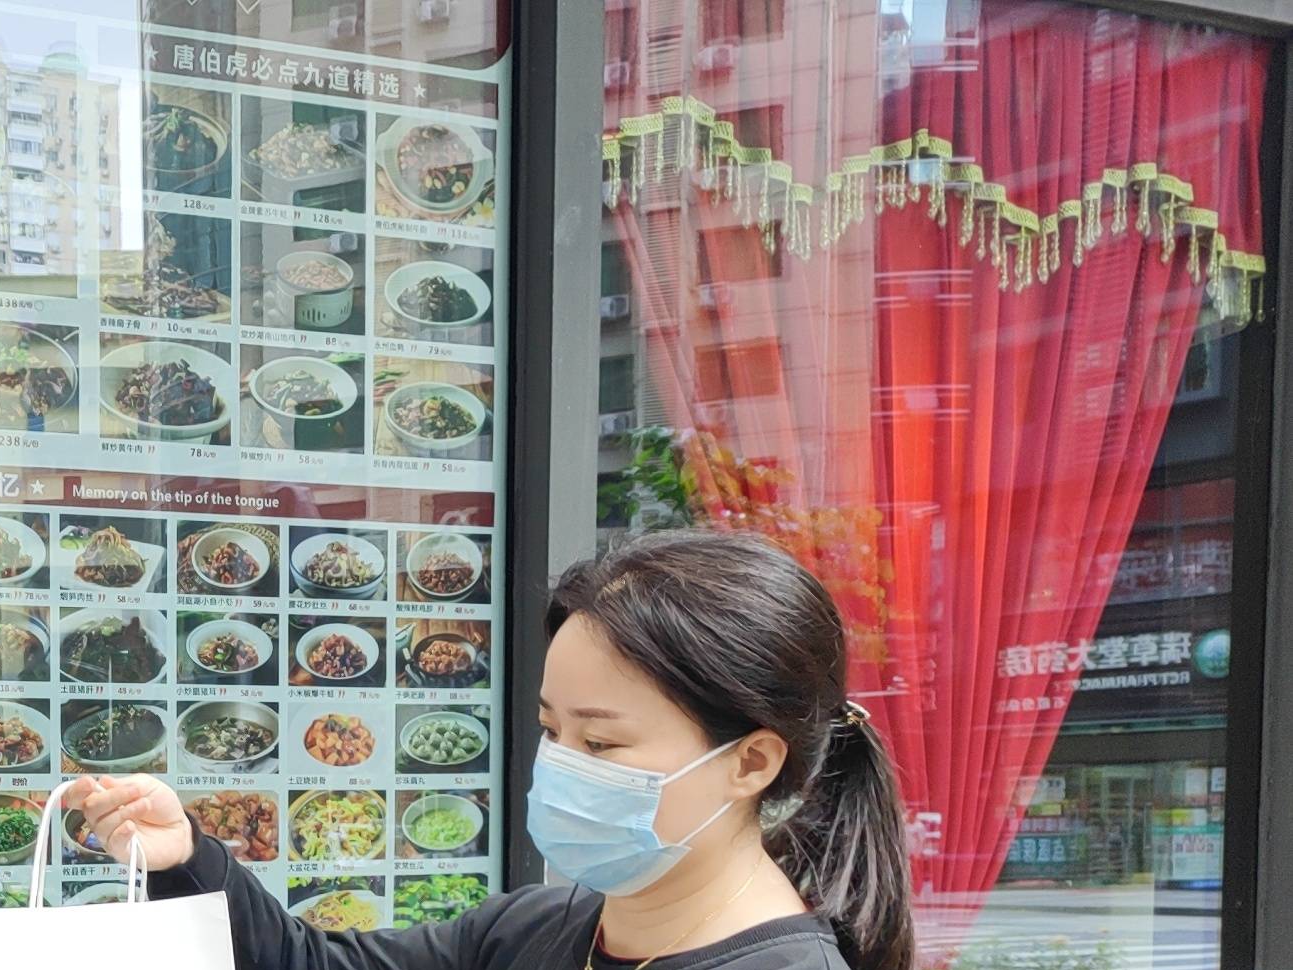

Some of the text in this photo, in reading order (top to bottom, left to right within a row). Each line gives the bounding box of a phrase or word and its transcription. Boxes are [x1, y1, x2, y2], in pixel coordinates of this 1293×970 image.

[173, 44, 401, 99] 唐伯虎必点九道精选
[72, 484, 280, 511] Memory on the tip of the tongue
